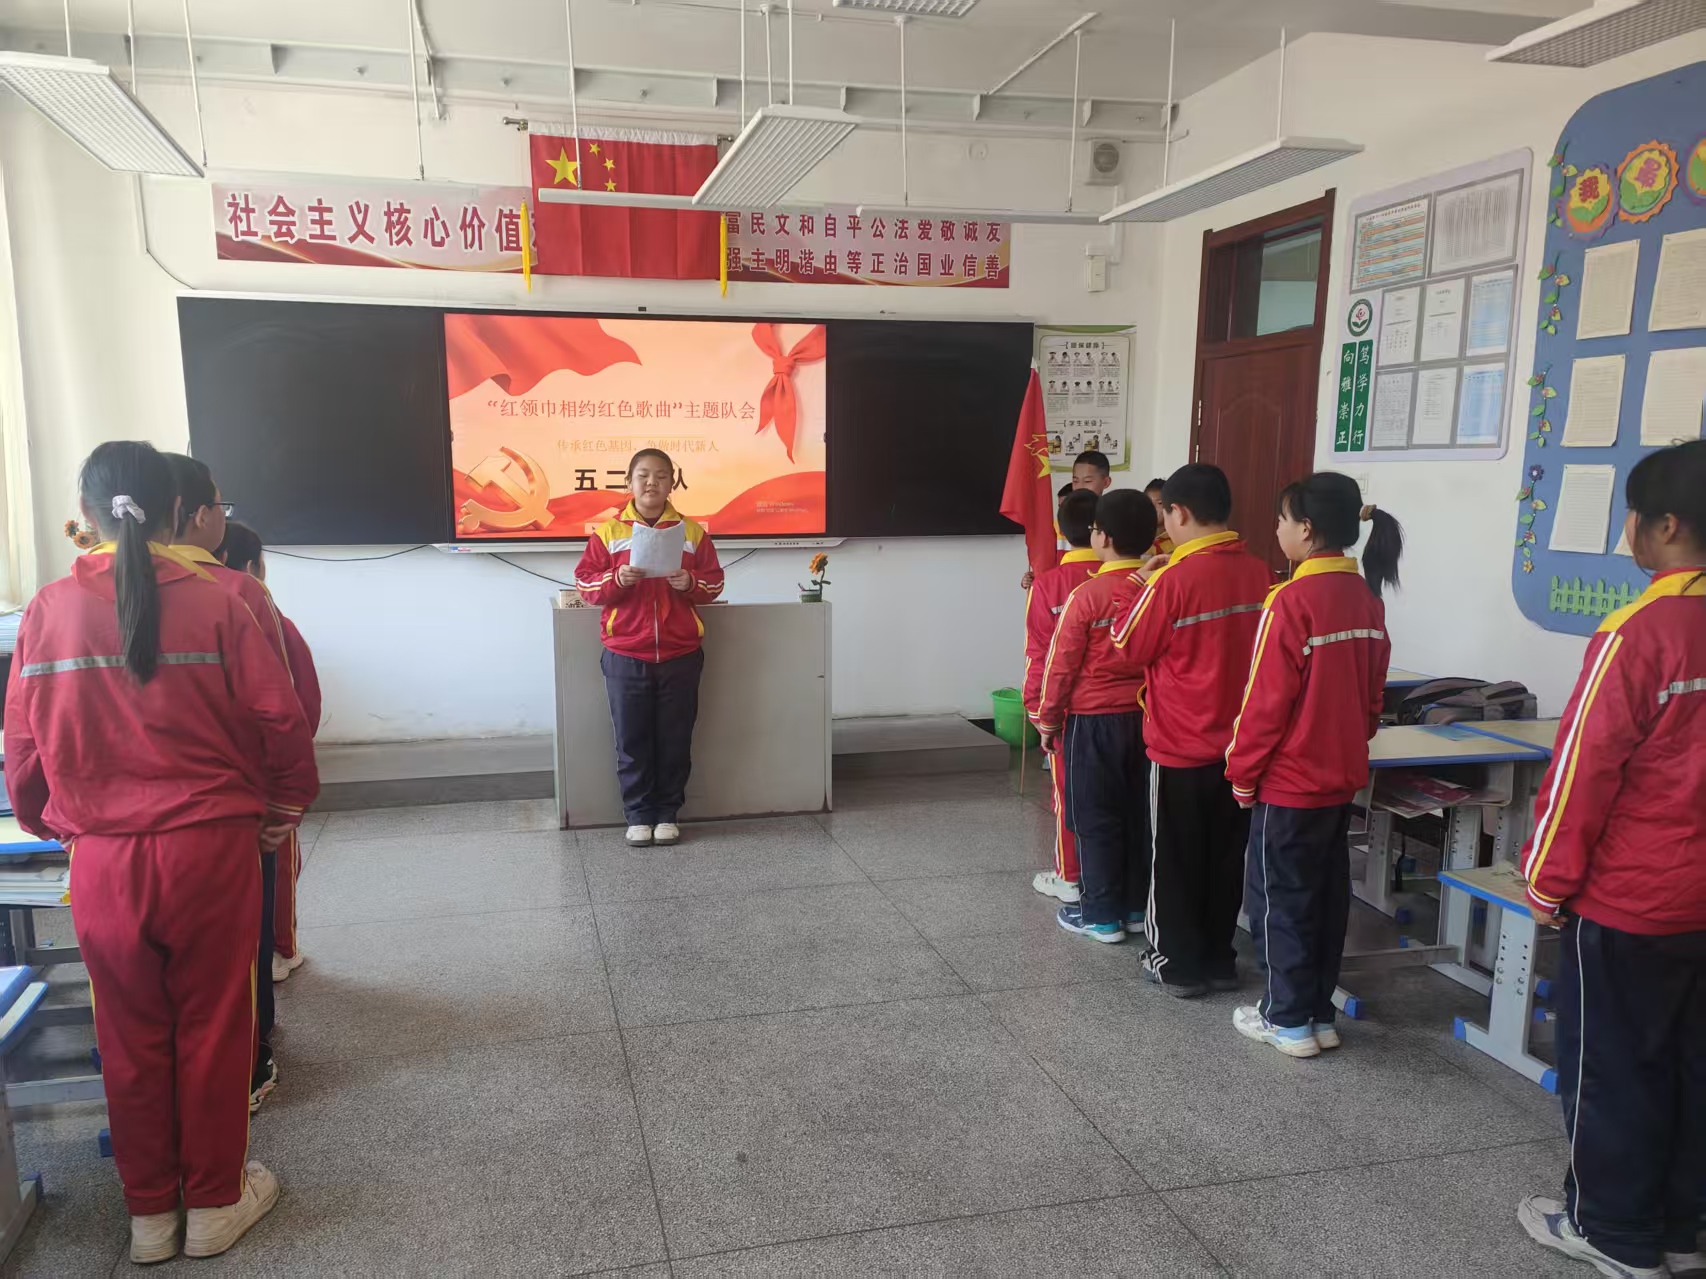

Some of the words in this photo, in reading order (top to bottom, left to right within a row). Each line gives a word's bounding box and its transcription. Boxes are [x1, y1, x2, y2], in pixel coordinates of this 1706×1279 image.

[227, 192, 536, 252] 社会主义核心价值
[1336, 350, 1354, 445] 向雅崇正
[1352, 346, 1370, 445] 笃学力行
